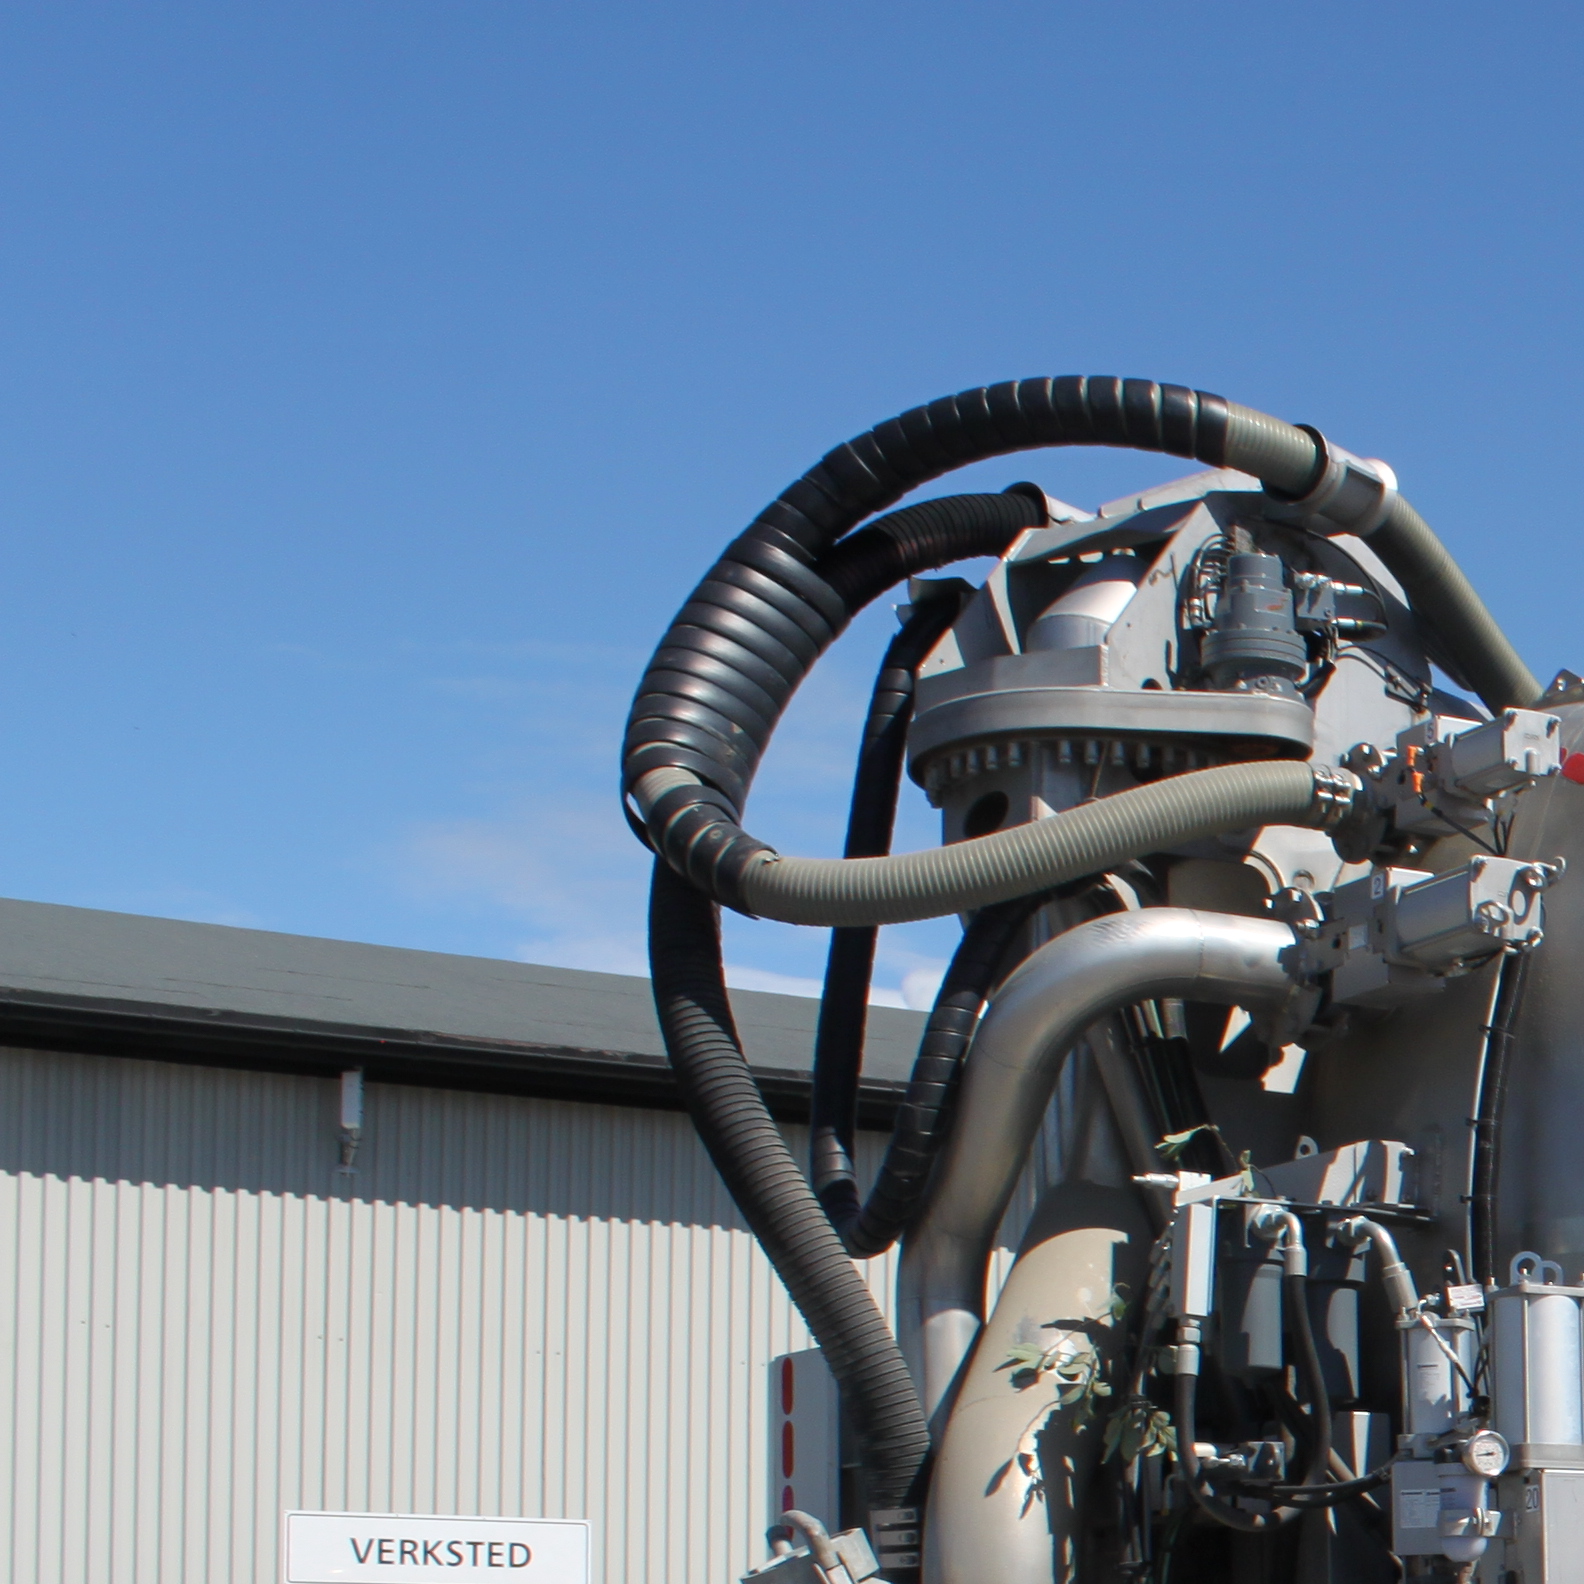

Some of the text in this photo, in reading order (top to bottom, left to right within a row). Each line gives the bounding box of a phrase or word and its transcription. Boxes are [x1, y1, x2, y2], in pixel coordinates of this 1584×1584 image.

[1373, 877, 1383, 895] 2
[1525, 1492, 1540, 1510] 20
[350, 1537, 533, 1568] VERKSTED
